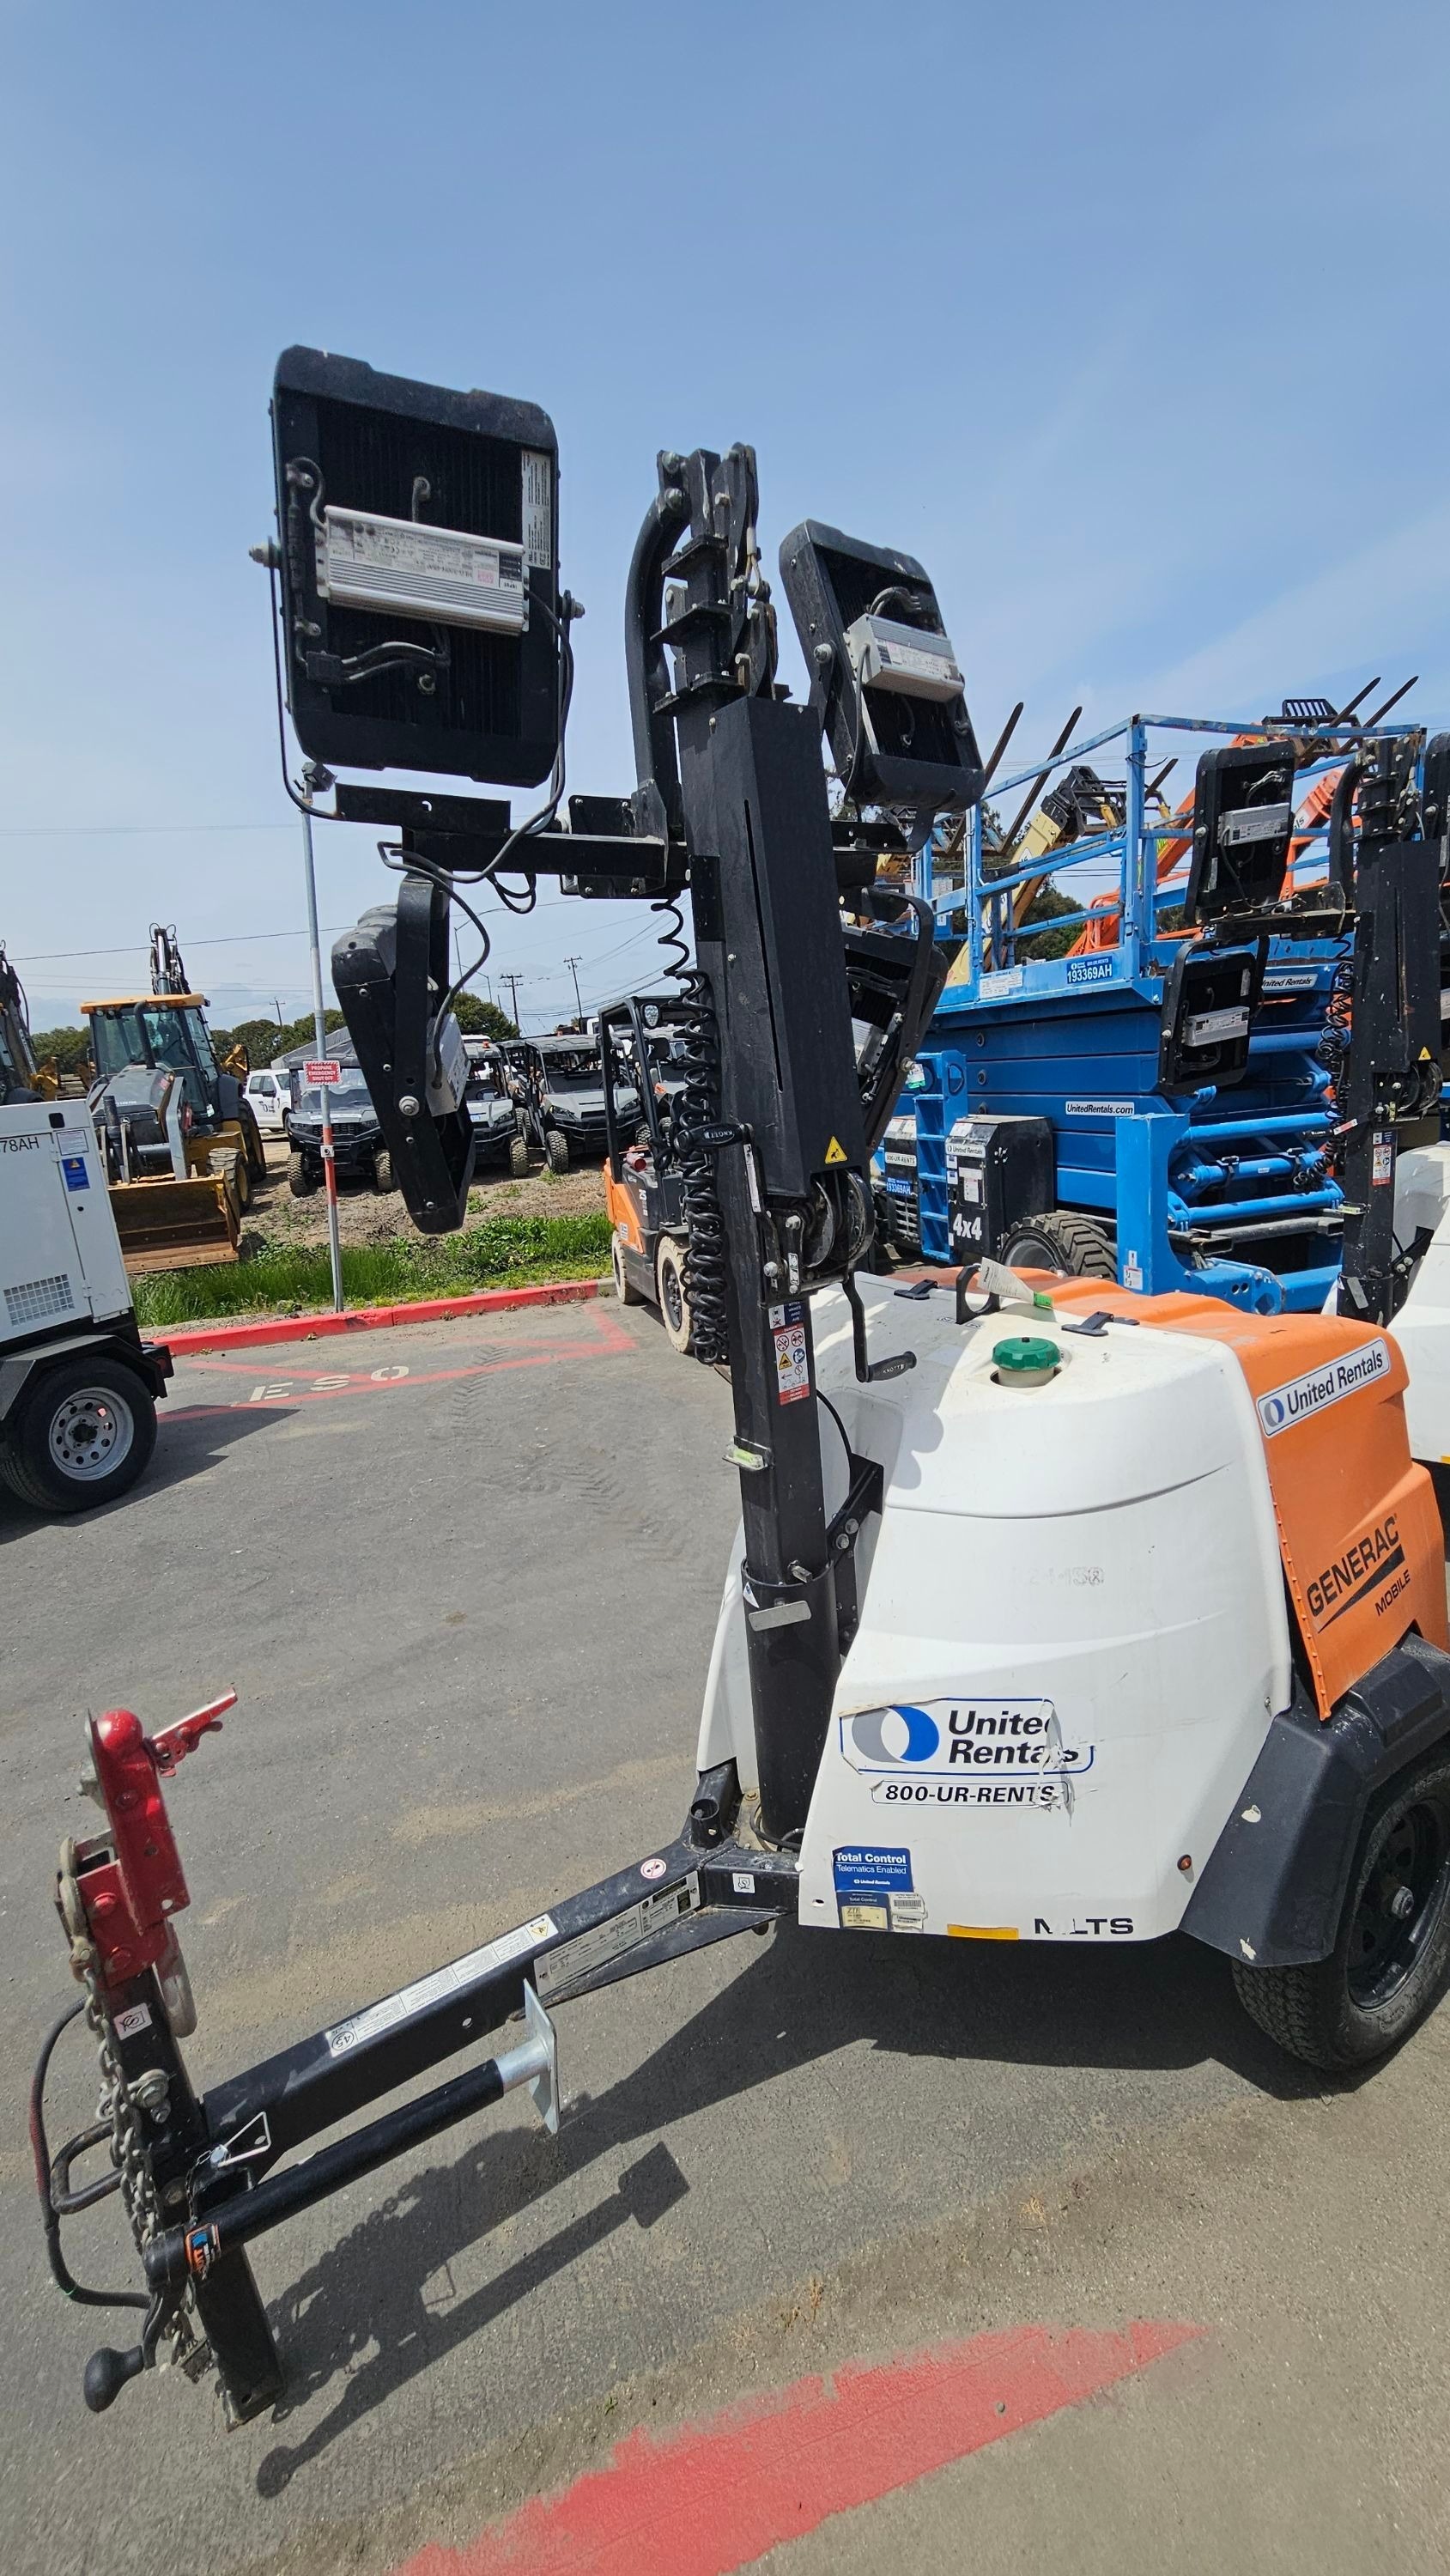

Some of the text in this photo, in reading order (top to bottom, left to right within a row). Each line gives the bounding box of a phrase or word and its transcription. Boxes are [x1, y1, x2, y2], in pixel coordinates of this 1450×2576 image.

[1067, 963, 1112, 982] 193369AH
[1066, 1104, 1133, 1115] UnitedRentals.com
[953, 1144, 983, 1155] United Rentals
[953, 1213, 982, 1241] 4x4
[883, 1365, 901, 1374] KNOTT
[1287, 1350, 1383, 1415] United Rentals
[1307, 1516, 1399, 1617] GENERAC
[1375, 1569, 1411, 1616] MOBILE
[836, 1853, 907, 1863] Total Control
[837, 1864, 874, 1874] Telematics
[336, 2032, 351, 2049] 45
